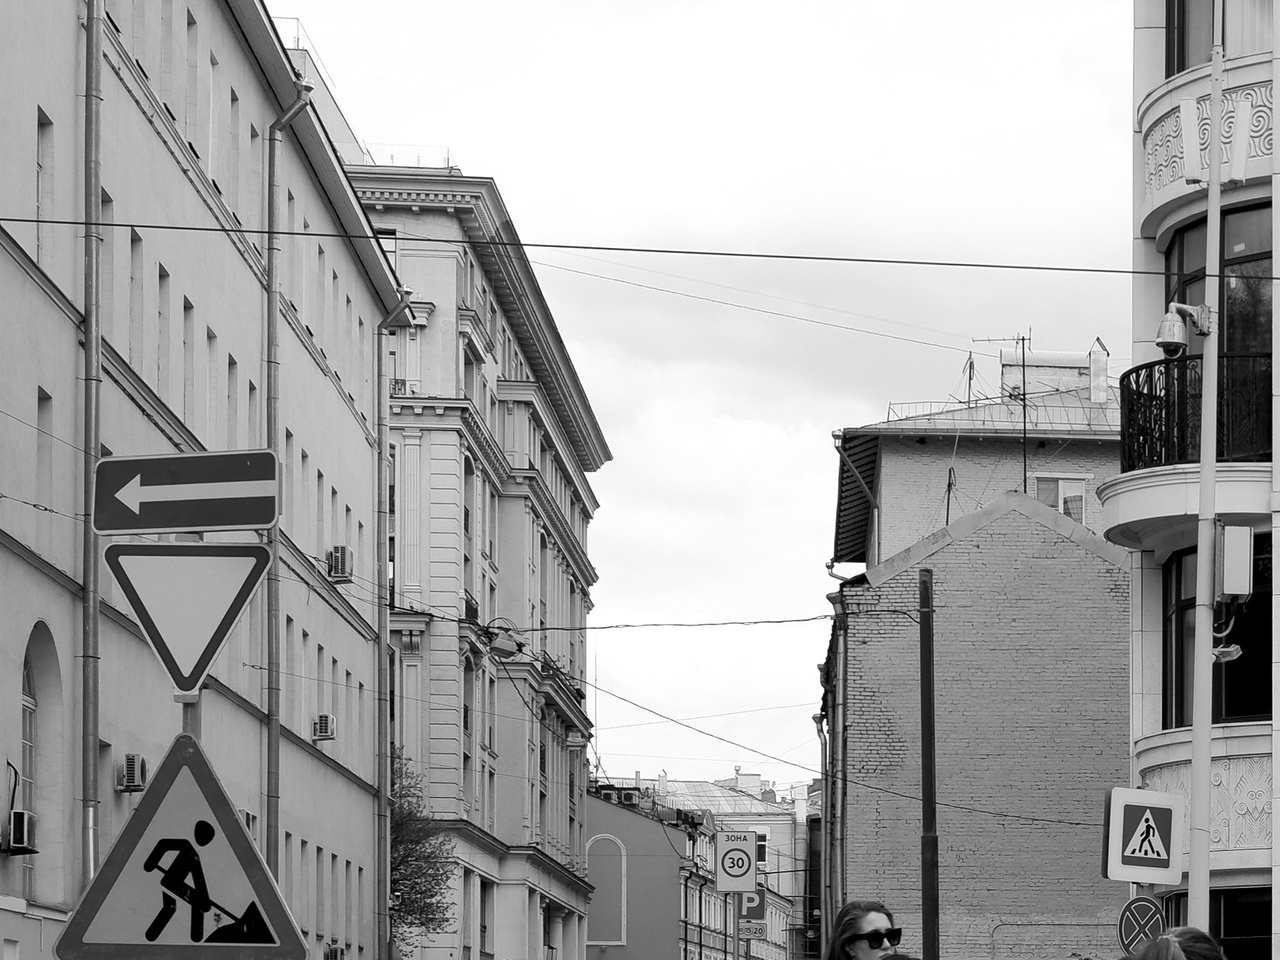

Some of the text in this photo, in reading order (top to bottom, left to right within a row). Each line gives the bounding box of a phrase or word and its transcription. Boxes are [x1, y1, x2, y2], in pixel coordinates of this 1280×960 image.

[725, 834, 748, 842] ЗОНА
[728, 857, 745, 869] 30
[741, 892, 760, 916] P
[753, 927, 764, 935] 20
